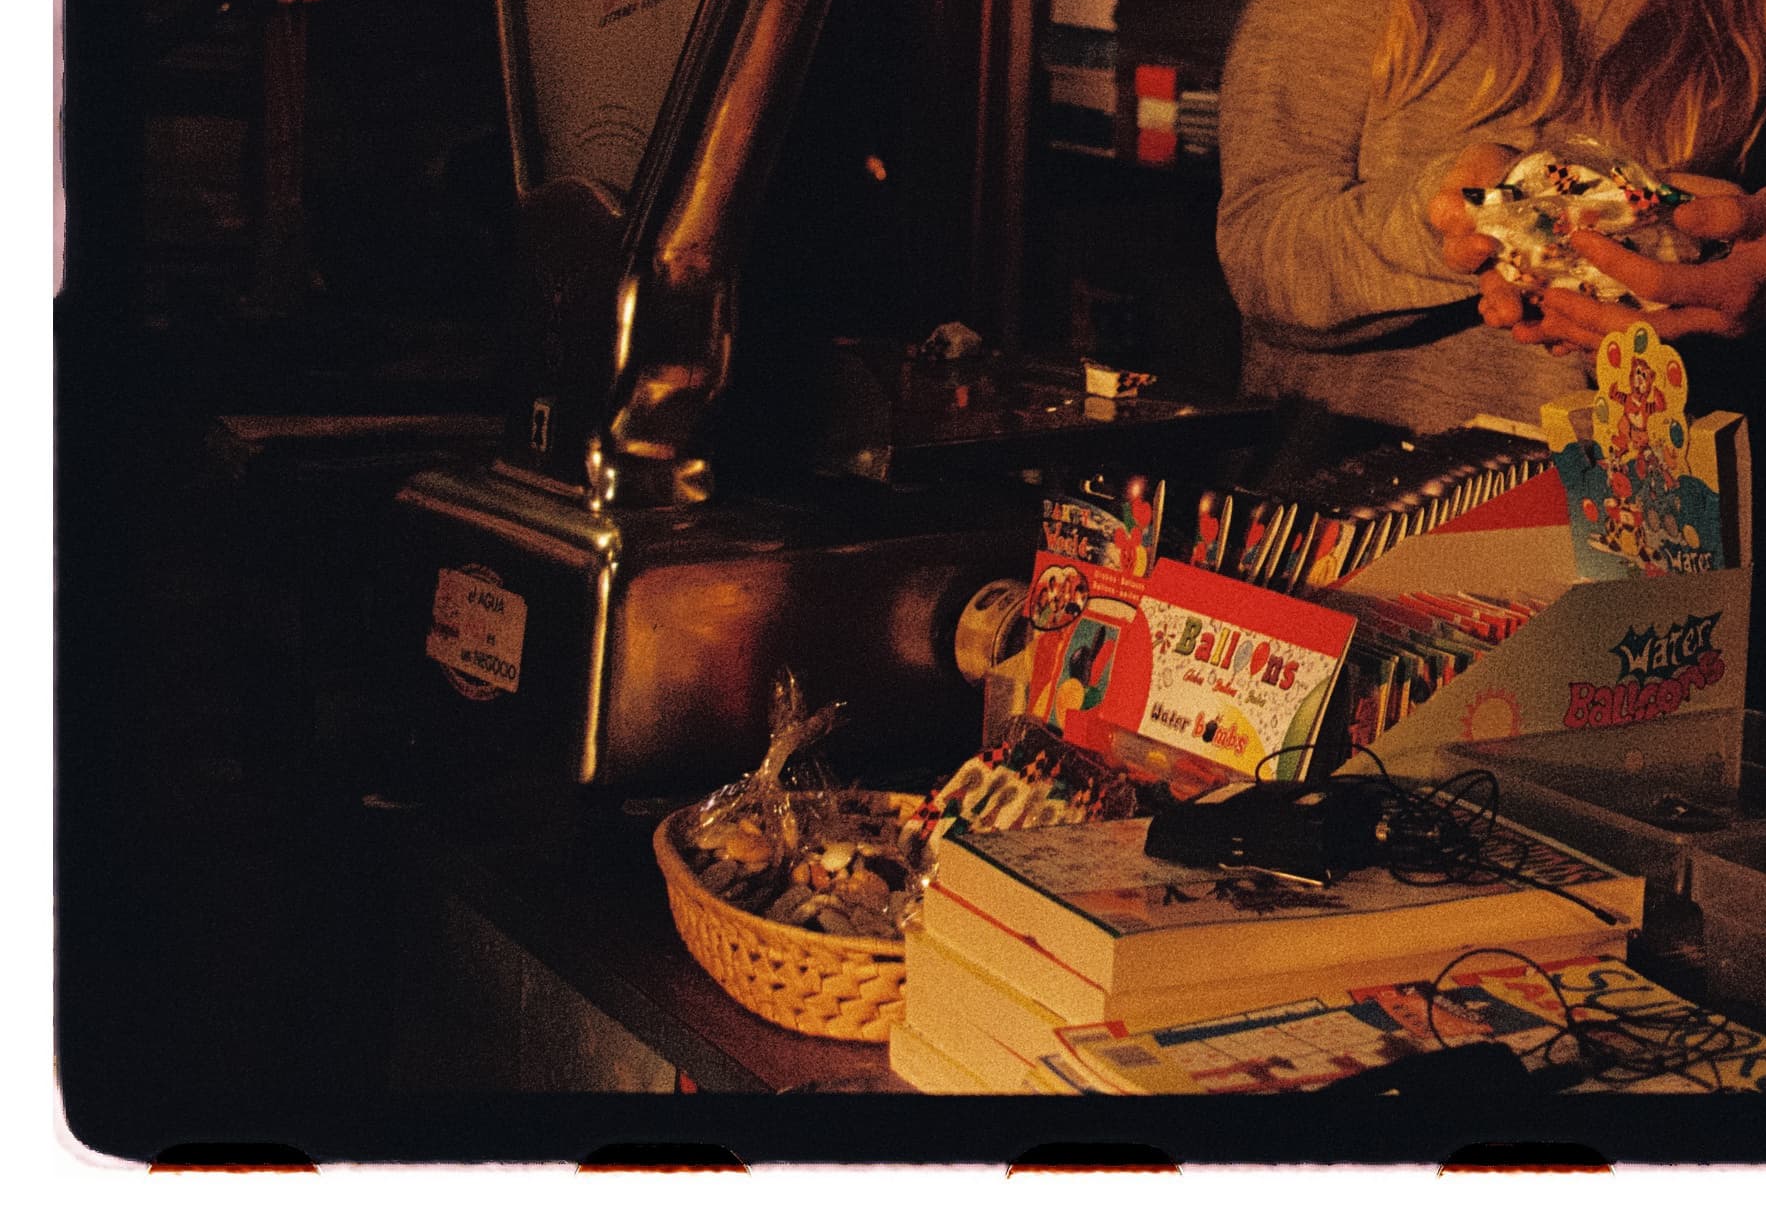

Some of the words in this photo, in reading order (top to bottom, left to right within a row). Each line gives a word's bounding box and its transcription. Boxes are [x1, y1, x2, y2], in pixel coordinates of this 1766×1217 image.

[1664, 546, 1713, 574] Water
[1174, 615, 1300, 691] Balloons
[1620, 618, 1713, 676] Water
[1151, 702, 1191, 732] Water
[1191, 711, 1249, 758] bombs
